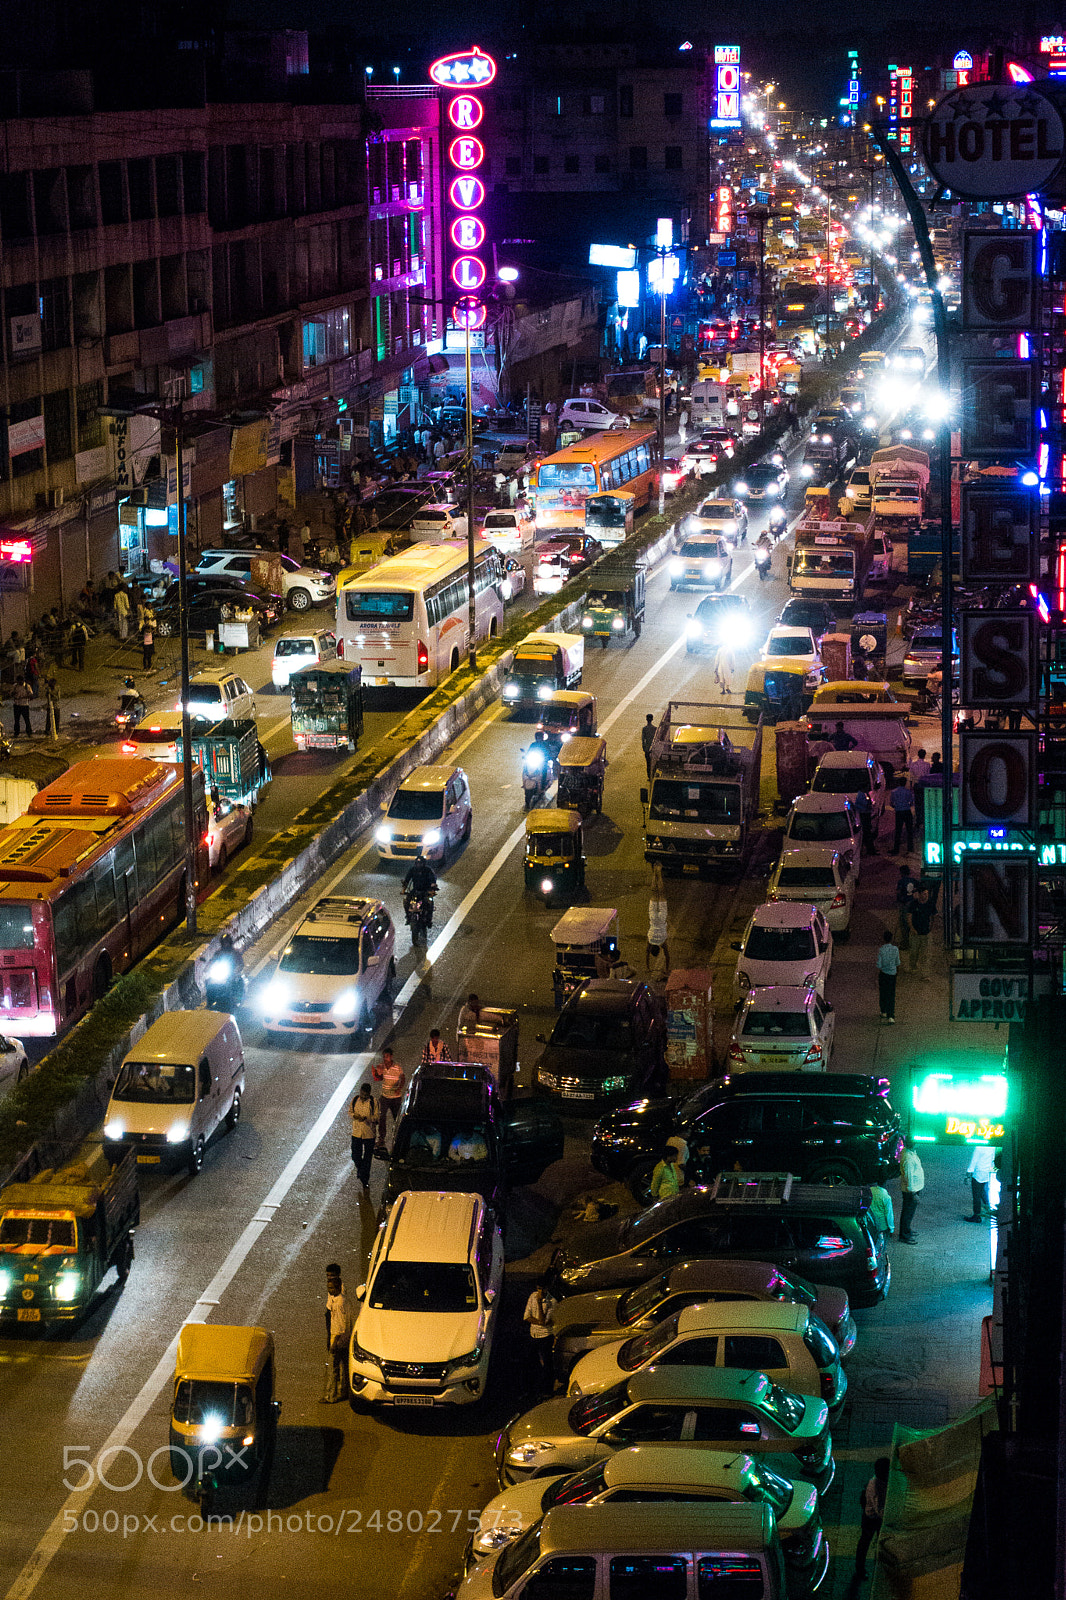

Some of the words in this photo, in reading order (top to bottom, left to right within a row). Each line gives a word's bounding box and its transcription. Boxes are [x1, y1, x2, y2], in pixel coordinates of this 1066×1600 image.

[719, 66, 739, 117] OM
[930, 119, 1060, 163] HOTEL
[718, 188, 730, 231] BAR
